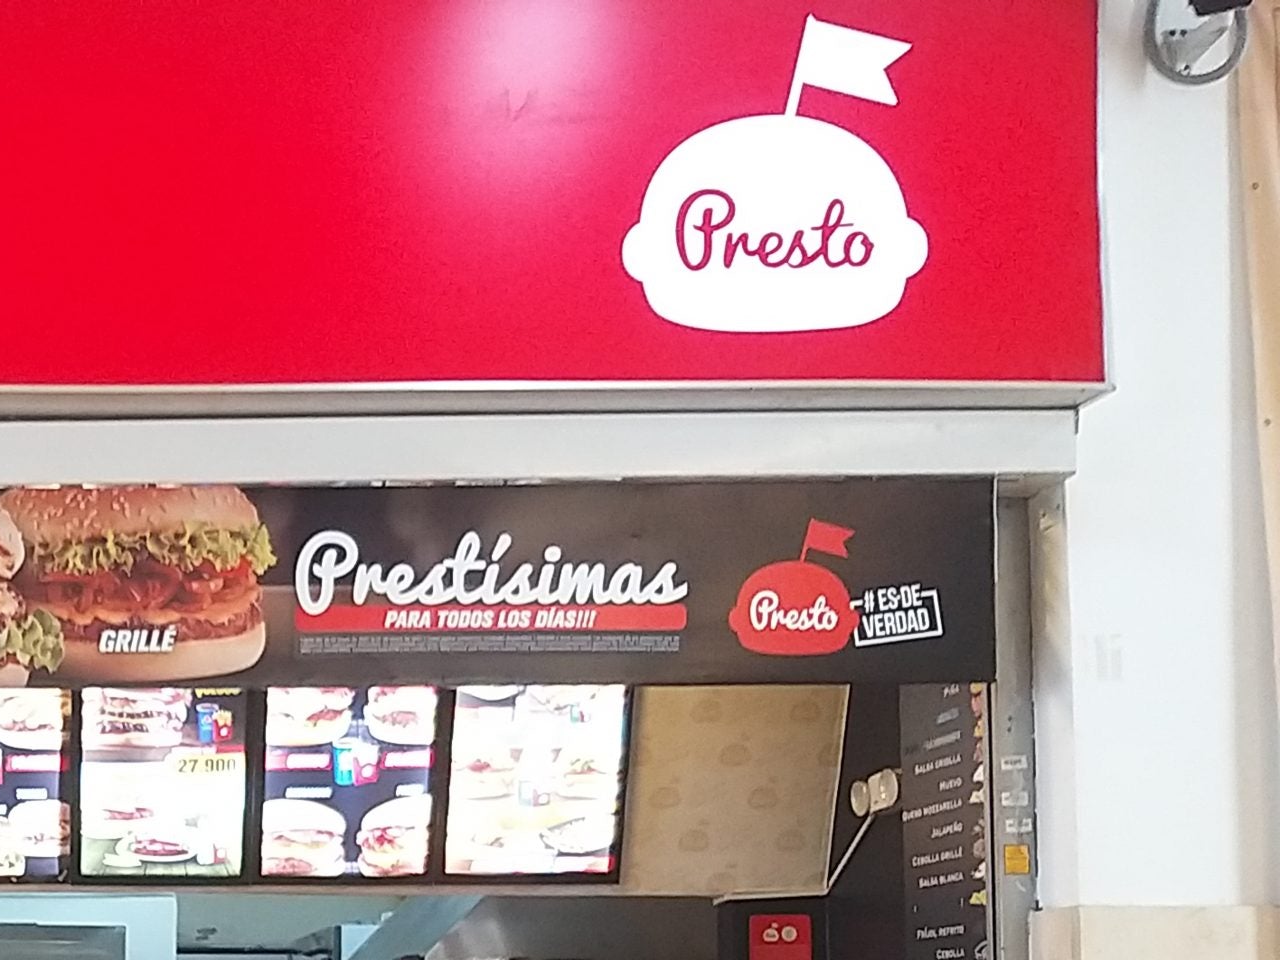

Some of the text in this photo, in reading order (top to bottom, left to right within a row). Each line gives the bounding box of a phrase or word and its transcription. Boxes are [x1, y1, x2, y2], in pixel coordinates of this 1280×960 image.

[675, 189, 874, 271] Presto
[384, 609, 431, 628] PARA
[436, 610, 495, 628] TODOS
[497, 610, 532, 628] LOS
[749, 590, 838, 631] Presto
[862, 608, 929, 638] VERDAD
